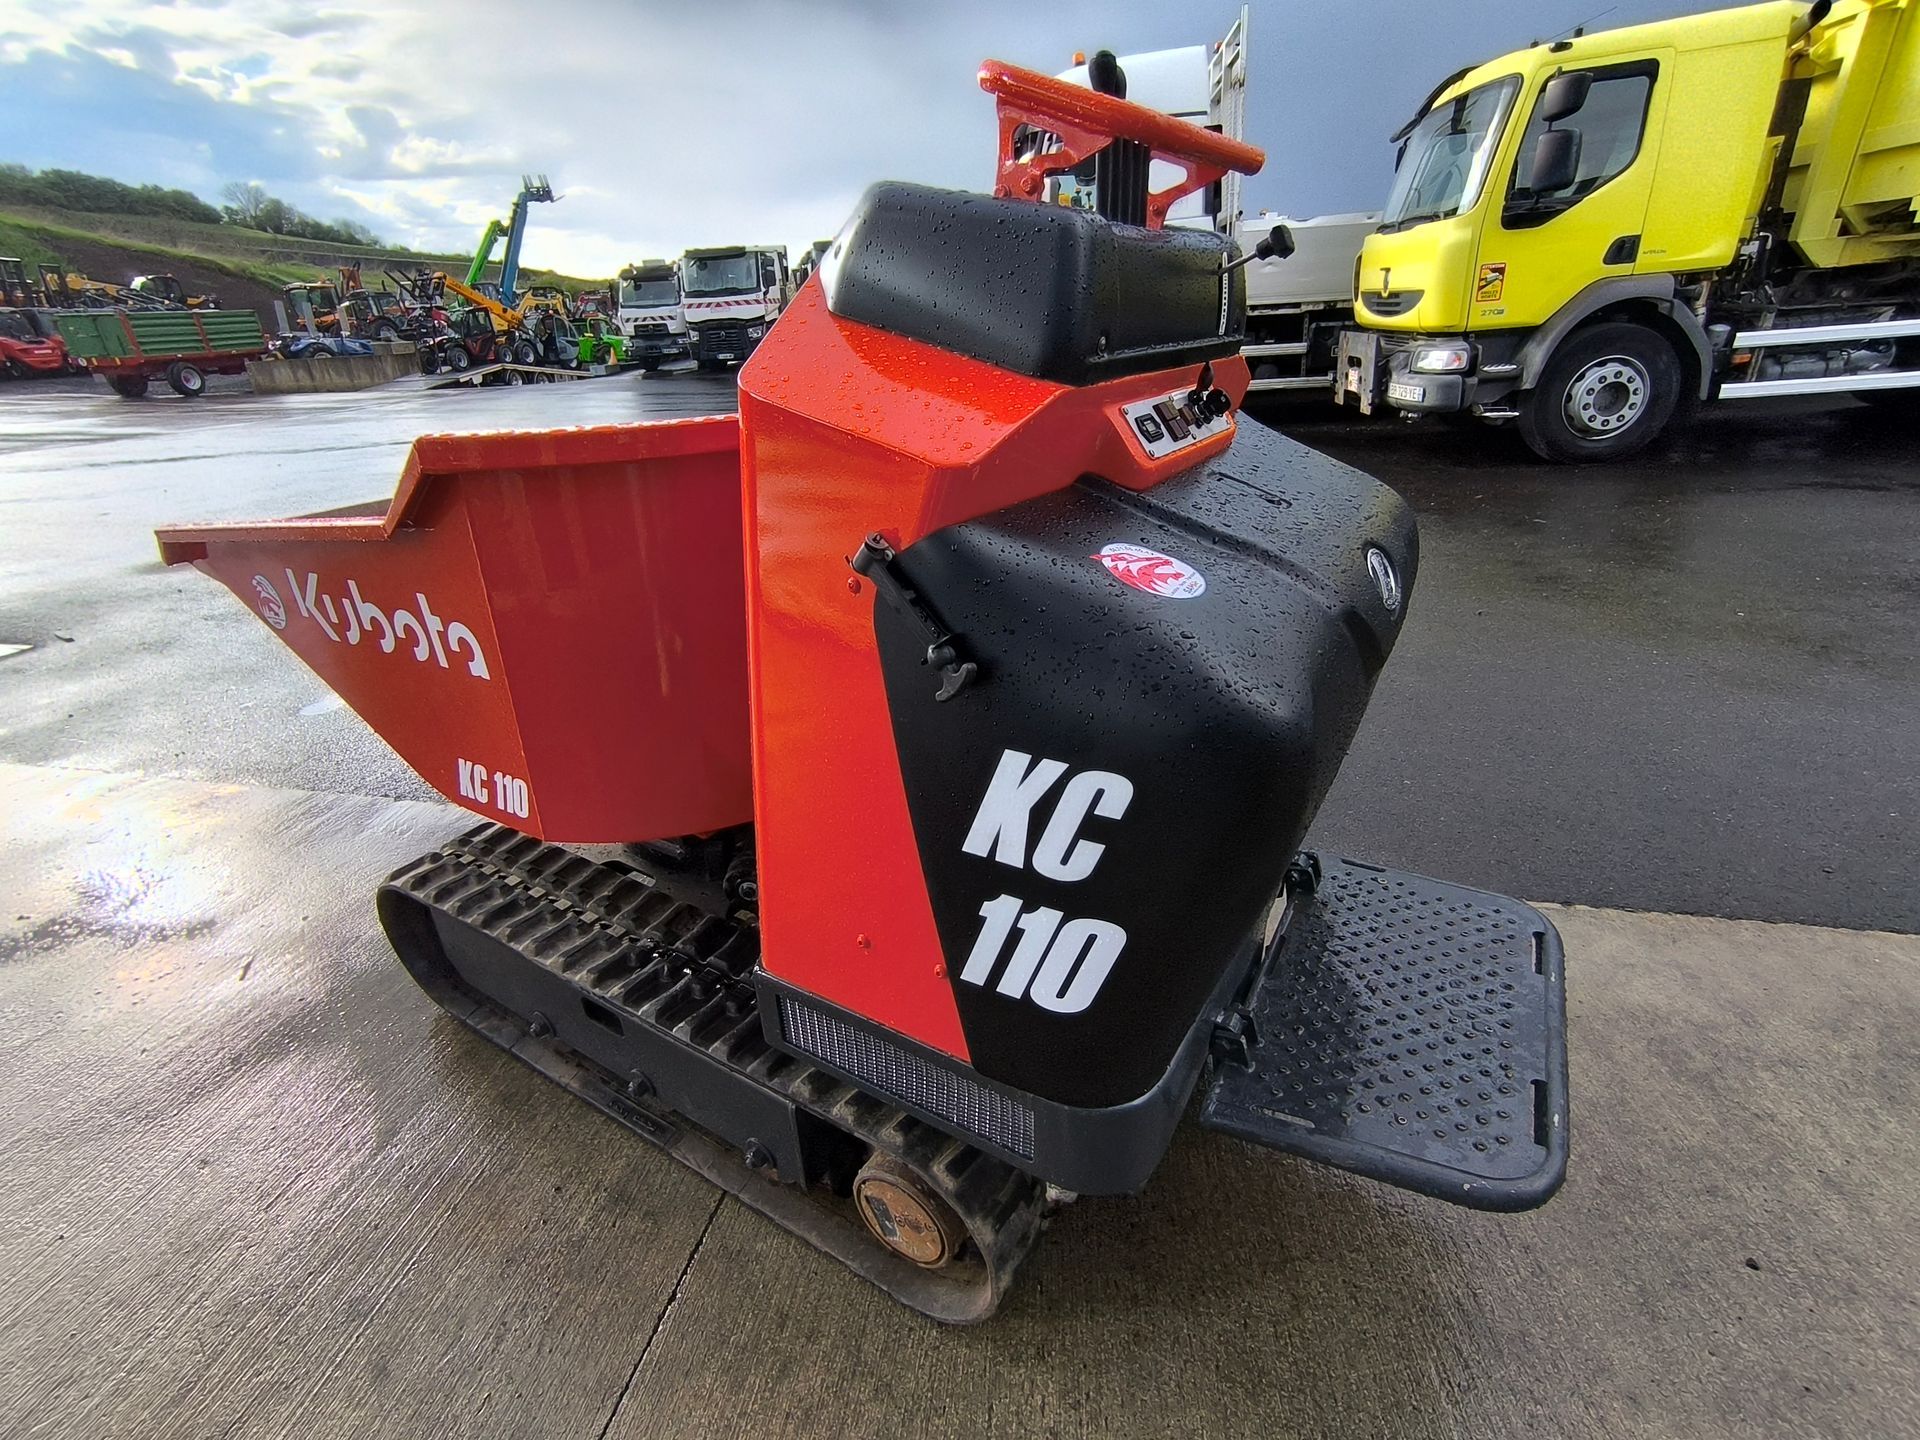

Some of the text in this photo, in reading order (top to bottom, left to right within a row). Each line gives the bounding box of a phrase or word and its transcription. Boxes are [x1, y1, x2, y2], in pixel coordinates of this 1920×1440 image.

[285, 568, 491, 680] Kubota
[457, 758, 530, 819] KC 110
[961, 748, 1134, 882] KC
[960, 893, 1127, 1013] 110
